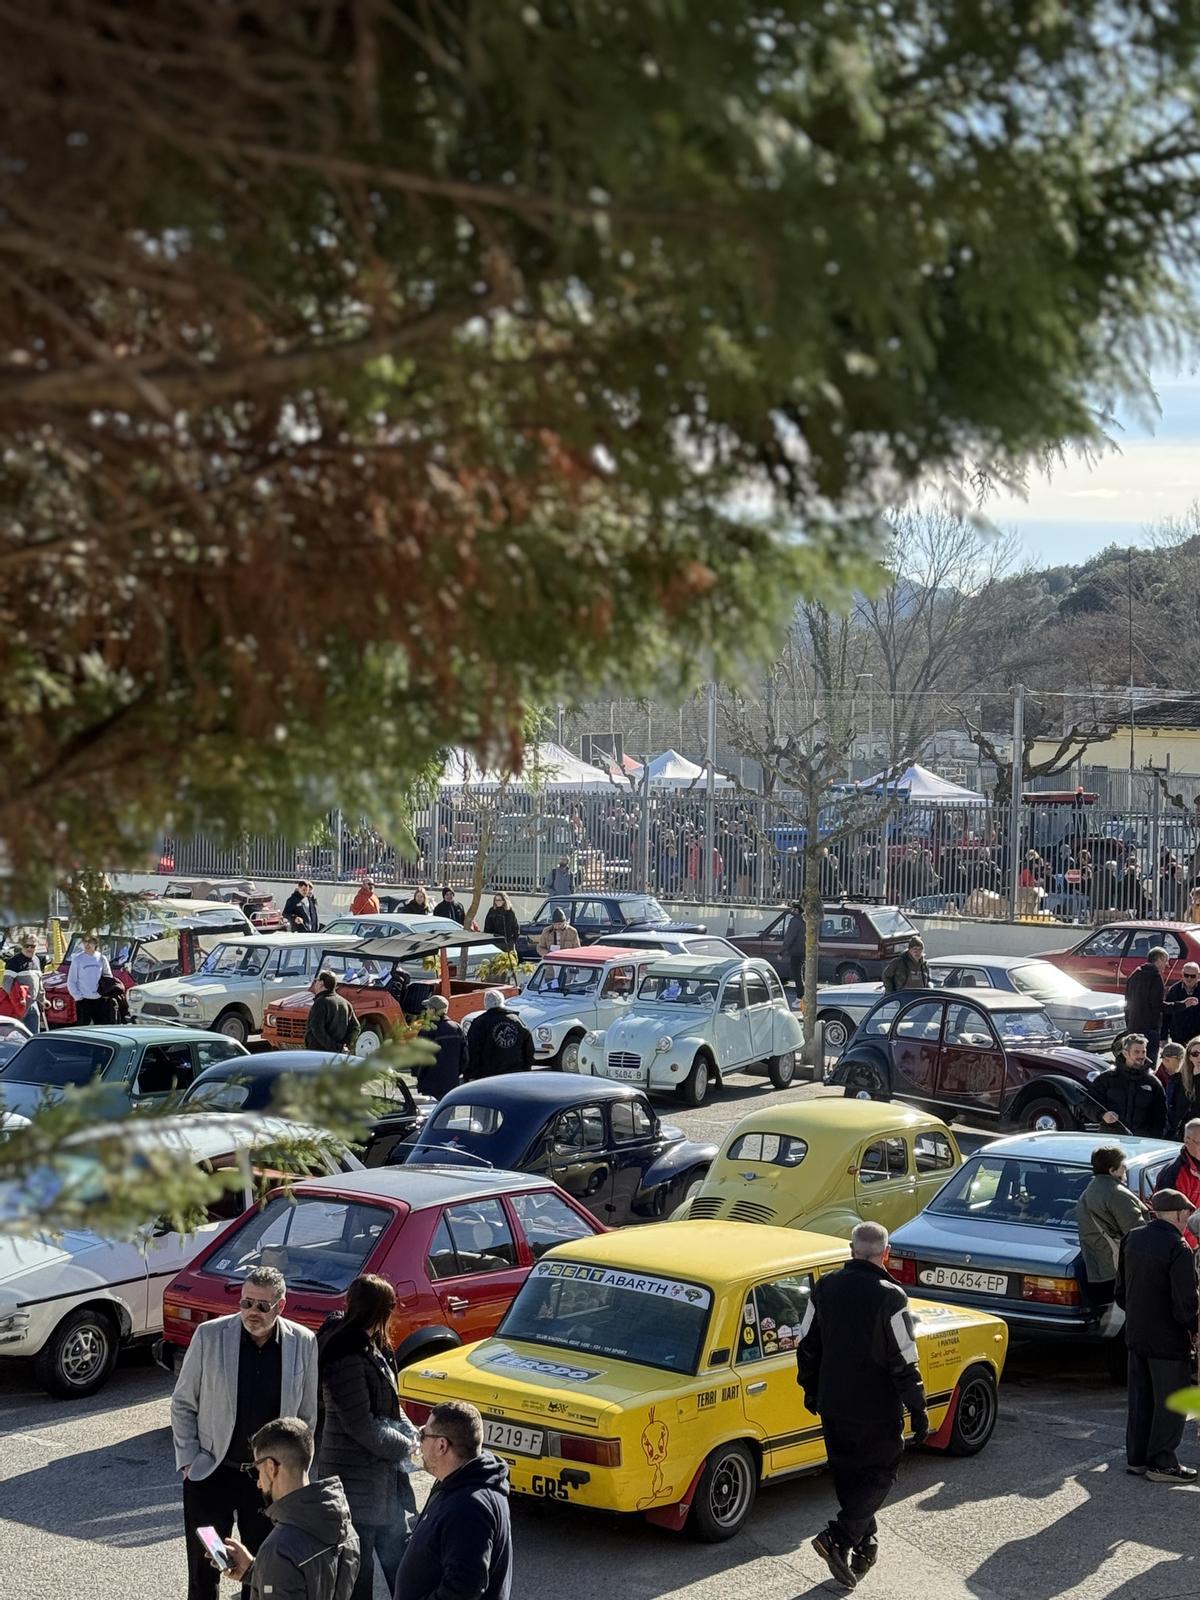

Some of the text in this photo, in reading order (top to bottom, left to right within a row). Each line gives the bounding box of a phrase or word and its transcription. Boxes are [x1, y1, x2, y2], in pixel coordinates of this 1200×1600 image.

[549, 1264, 669, 1295] SEAT ABARTH
[926, 1269, 1004, 1292] E B-0454-EP
[493, 1355, 589, 1379] FERODO
